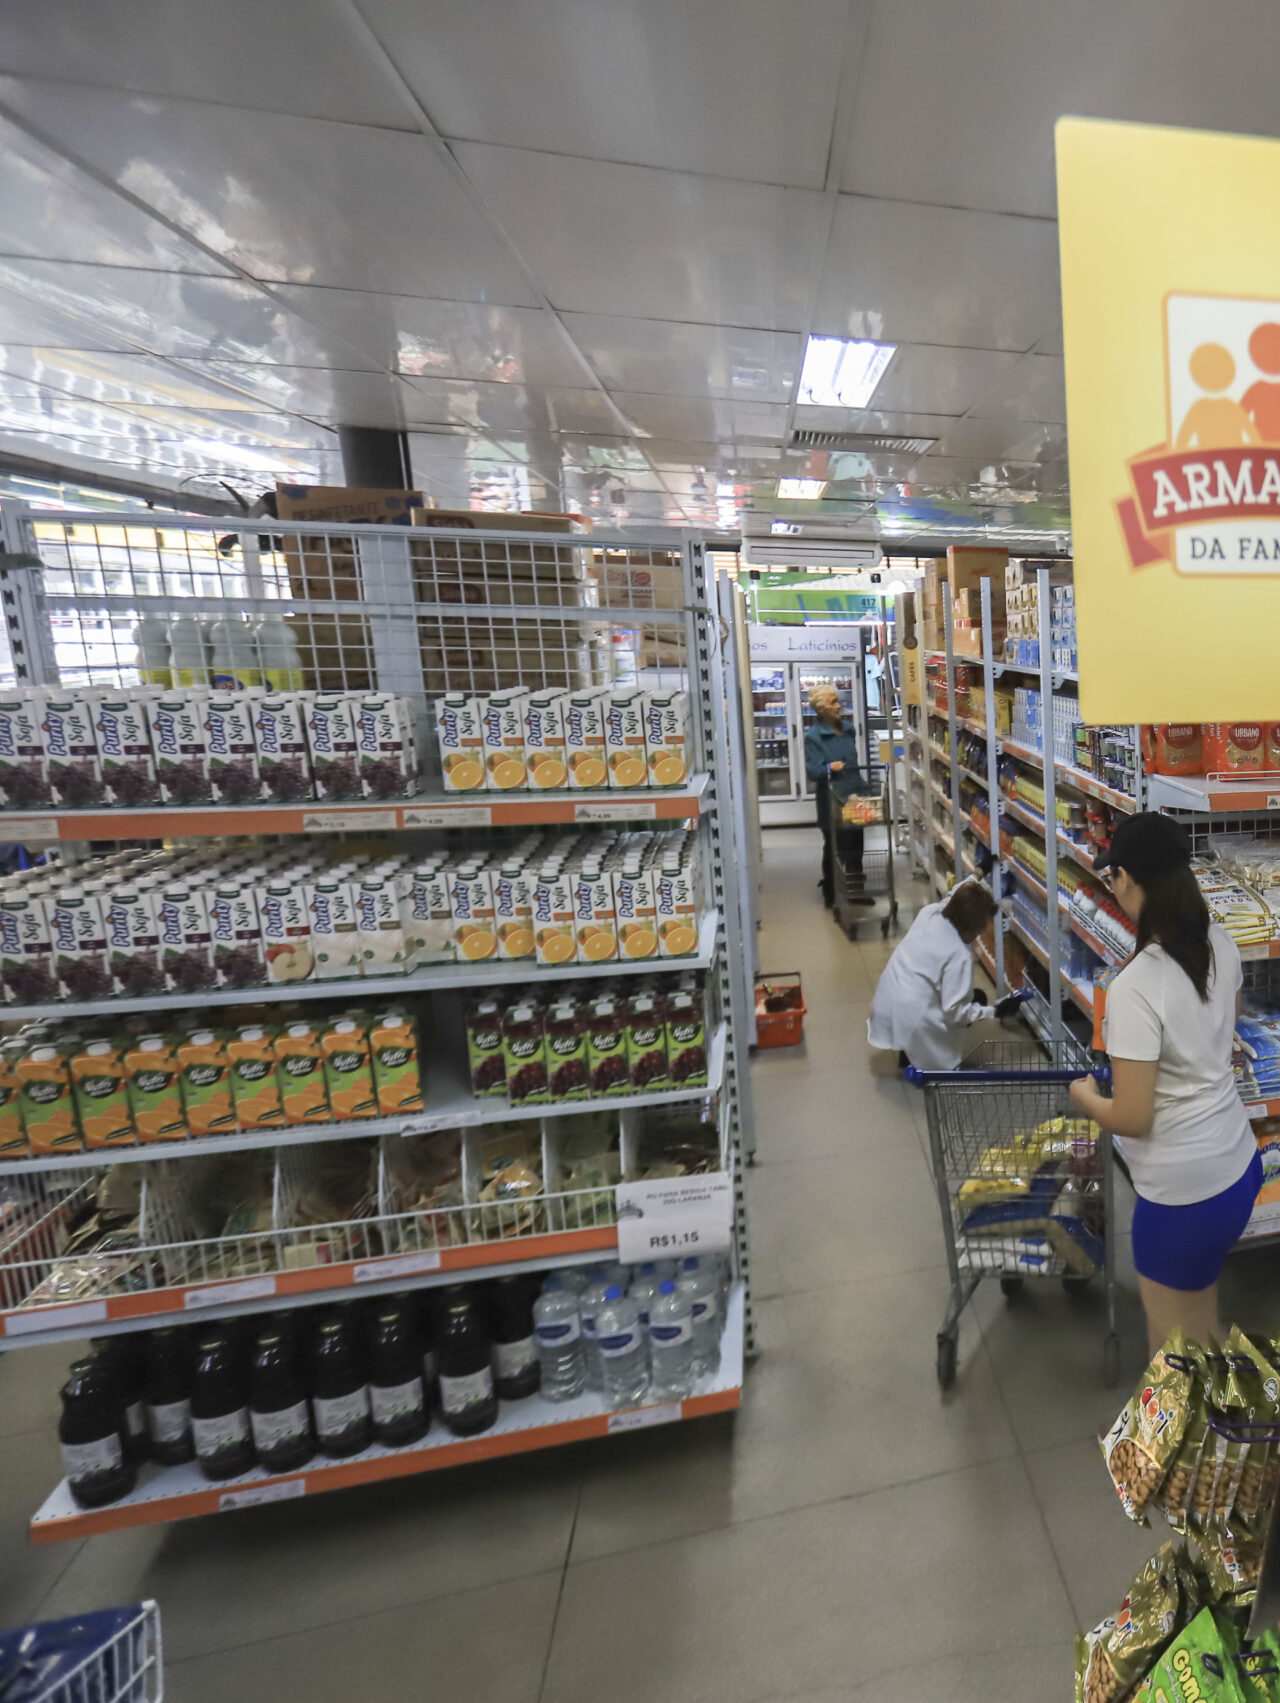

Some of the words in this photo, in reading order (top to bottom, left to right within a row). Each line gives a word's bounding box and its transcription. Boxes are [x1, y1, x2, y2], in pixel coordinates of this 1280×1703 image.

[1190, 537, 1226, 560] DA
[860, 598, 876, 607] 417
[788, 637, 857, 651] Laticínios
[15, 715, 35, 743] Soja
[41, 711, 67, 756] Purity
[67, 714, 86, 743] Soja
[96, 711, 121, 756] Purity
[122, 714, 141, 742] Soja
[152, 711, 177, 755] Purity
[177, 714, 196, 742] Soja
[203, 711, 228, 754] Purity
[228, 714, 247, 741] Soja
[255, 710, 278, 753] Purity
[280, 714, 296, 740] Soja
[309, 710, 331, 753] Purity
[333, 714, 350, 739] Soja
[356, 710, 377, 752] Purity
[379, 714, 396, 739] Soja
[439, 708, 459, 747] Purity
[460, 711, 475, 735] Soja
[483, 708, 502, 747] Purity
[503, 711, 518, 735] Soja
[524, 708, 542, 747] Purity
[543, 711, 560, 735] Soja
[565, 708, 583, 746] Purity
[585, 711, 601, 734] Soja
[606, 708, 623, 745] Purity
[625, 711, 640, 734] Soja
[646, 707, 663, 745] Purity
[664, 710, 679, 733] Soja
[1235, 727, 1260, 737] URBANO
[408, 882, 429, 921] Purity
[430, 884, 445, 909] Soja
[451, 882, 470, 919] Purity
[472, 883, 488, 907] Soja
[494, 879, 513, 917] Purity
[514, 881, 530, 905] Soja
[533, 884, 552, 922] Purity
[553, 886, 568, 910] Soja
[574, 882, 593, 921] Purity
[594, 884, 610, 908] Soja
[616, 880, 635, 918] Purity
[635, 882, 651, 906] Soja
[656, 878, 674, 916] Purity
[675, 880, 691, 903] Soja
[132, 907, 151, 933] Soja
[183, 905, 201, 931] Soja
[210, 899, 232, 941] Purity
[235, 902, 252, 927] Soja
[261, 896, 284, 938] Purity
[286, 899, 301, 925] Soja
[310, 894, 332, 934] Purity
[333, 896, 349, 921] Soja
[356, 892, 377, 932] Purity
[378, 894, 394, 919] Soja
[23, 913, 42, 940] Soja
[51, 908, 77, 951] Purity
[77, 911, 97, 938] Soja
[106, 904, 131, 947] Purity
[158, 902, 182, 944] Purity
[649, 1231, 700, 1249] R$1,15
[1172, 1647, 1208, 1703] Gom
